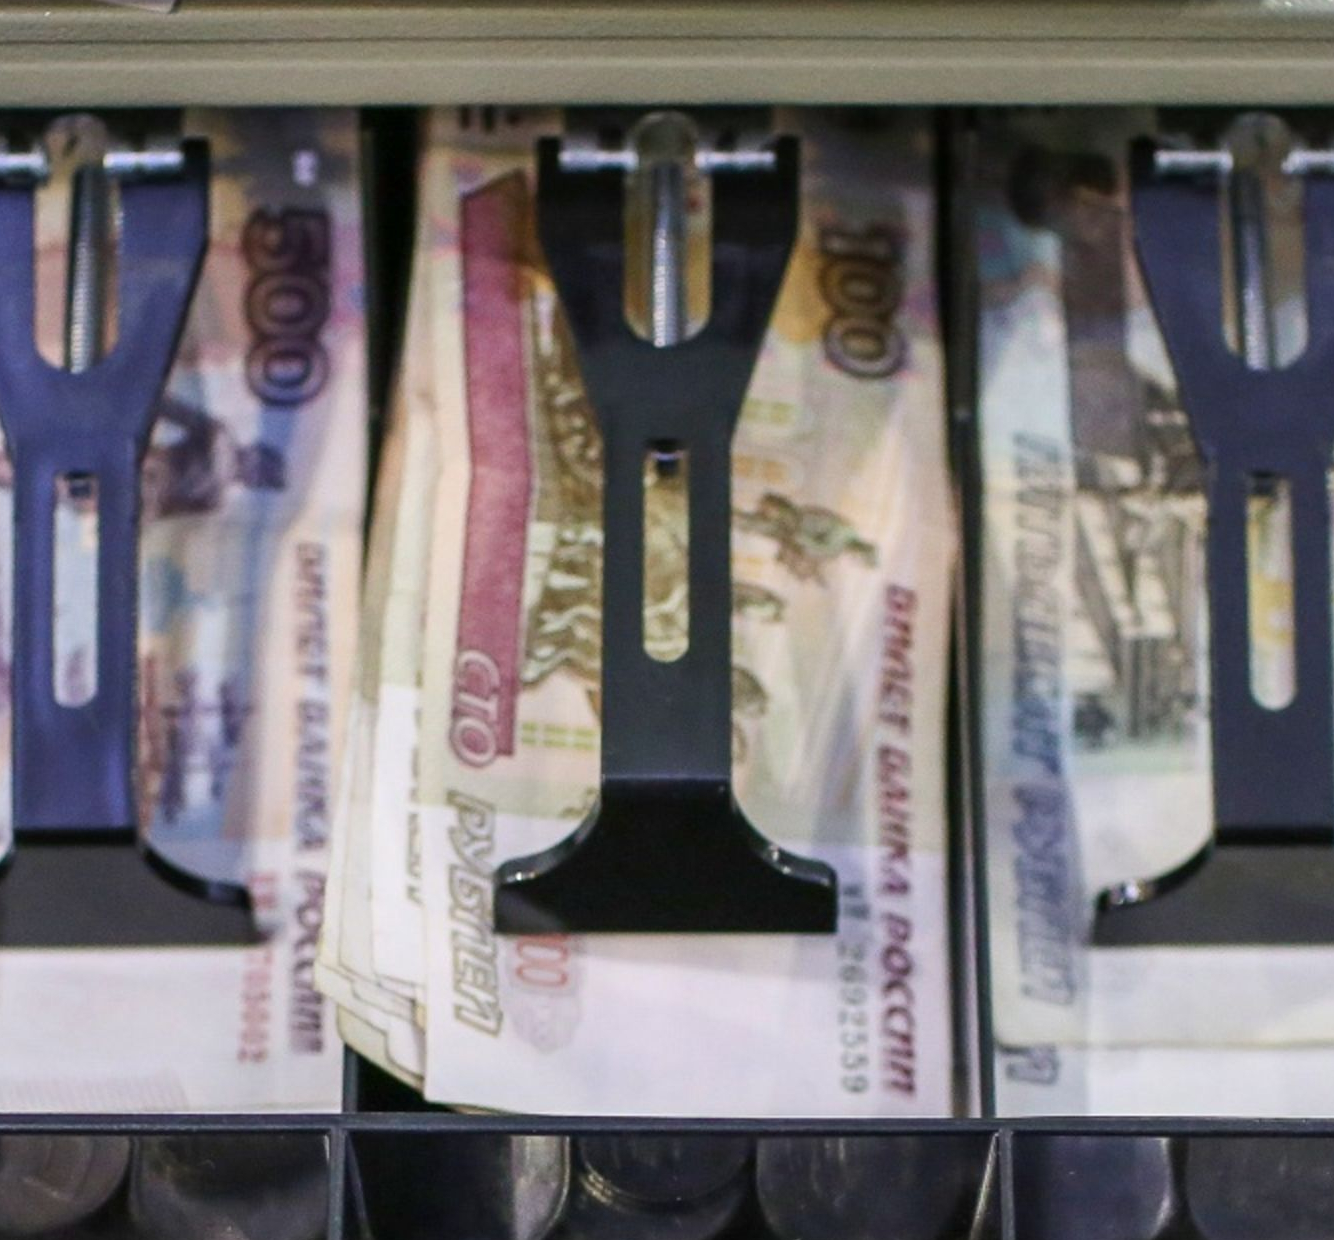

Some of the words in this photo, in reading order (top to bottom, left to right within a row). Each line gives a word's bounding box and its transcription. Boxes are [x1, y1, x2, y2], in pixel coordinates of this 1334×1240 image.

[449, 649, 501, 770] СТО
[879, 582, 917, 733] БИЛЕТ
[874, 745, 914, 898] БАНКА
[447, 788, 505, 1039] РУБЛЕЙ
[515, 932, 570, 989] 00
[878, 912, 916, 1097] РОССИИ
